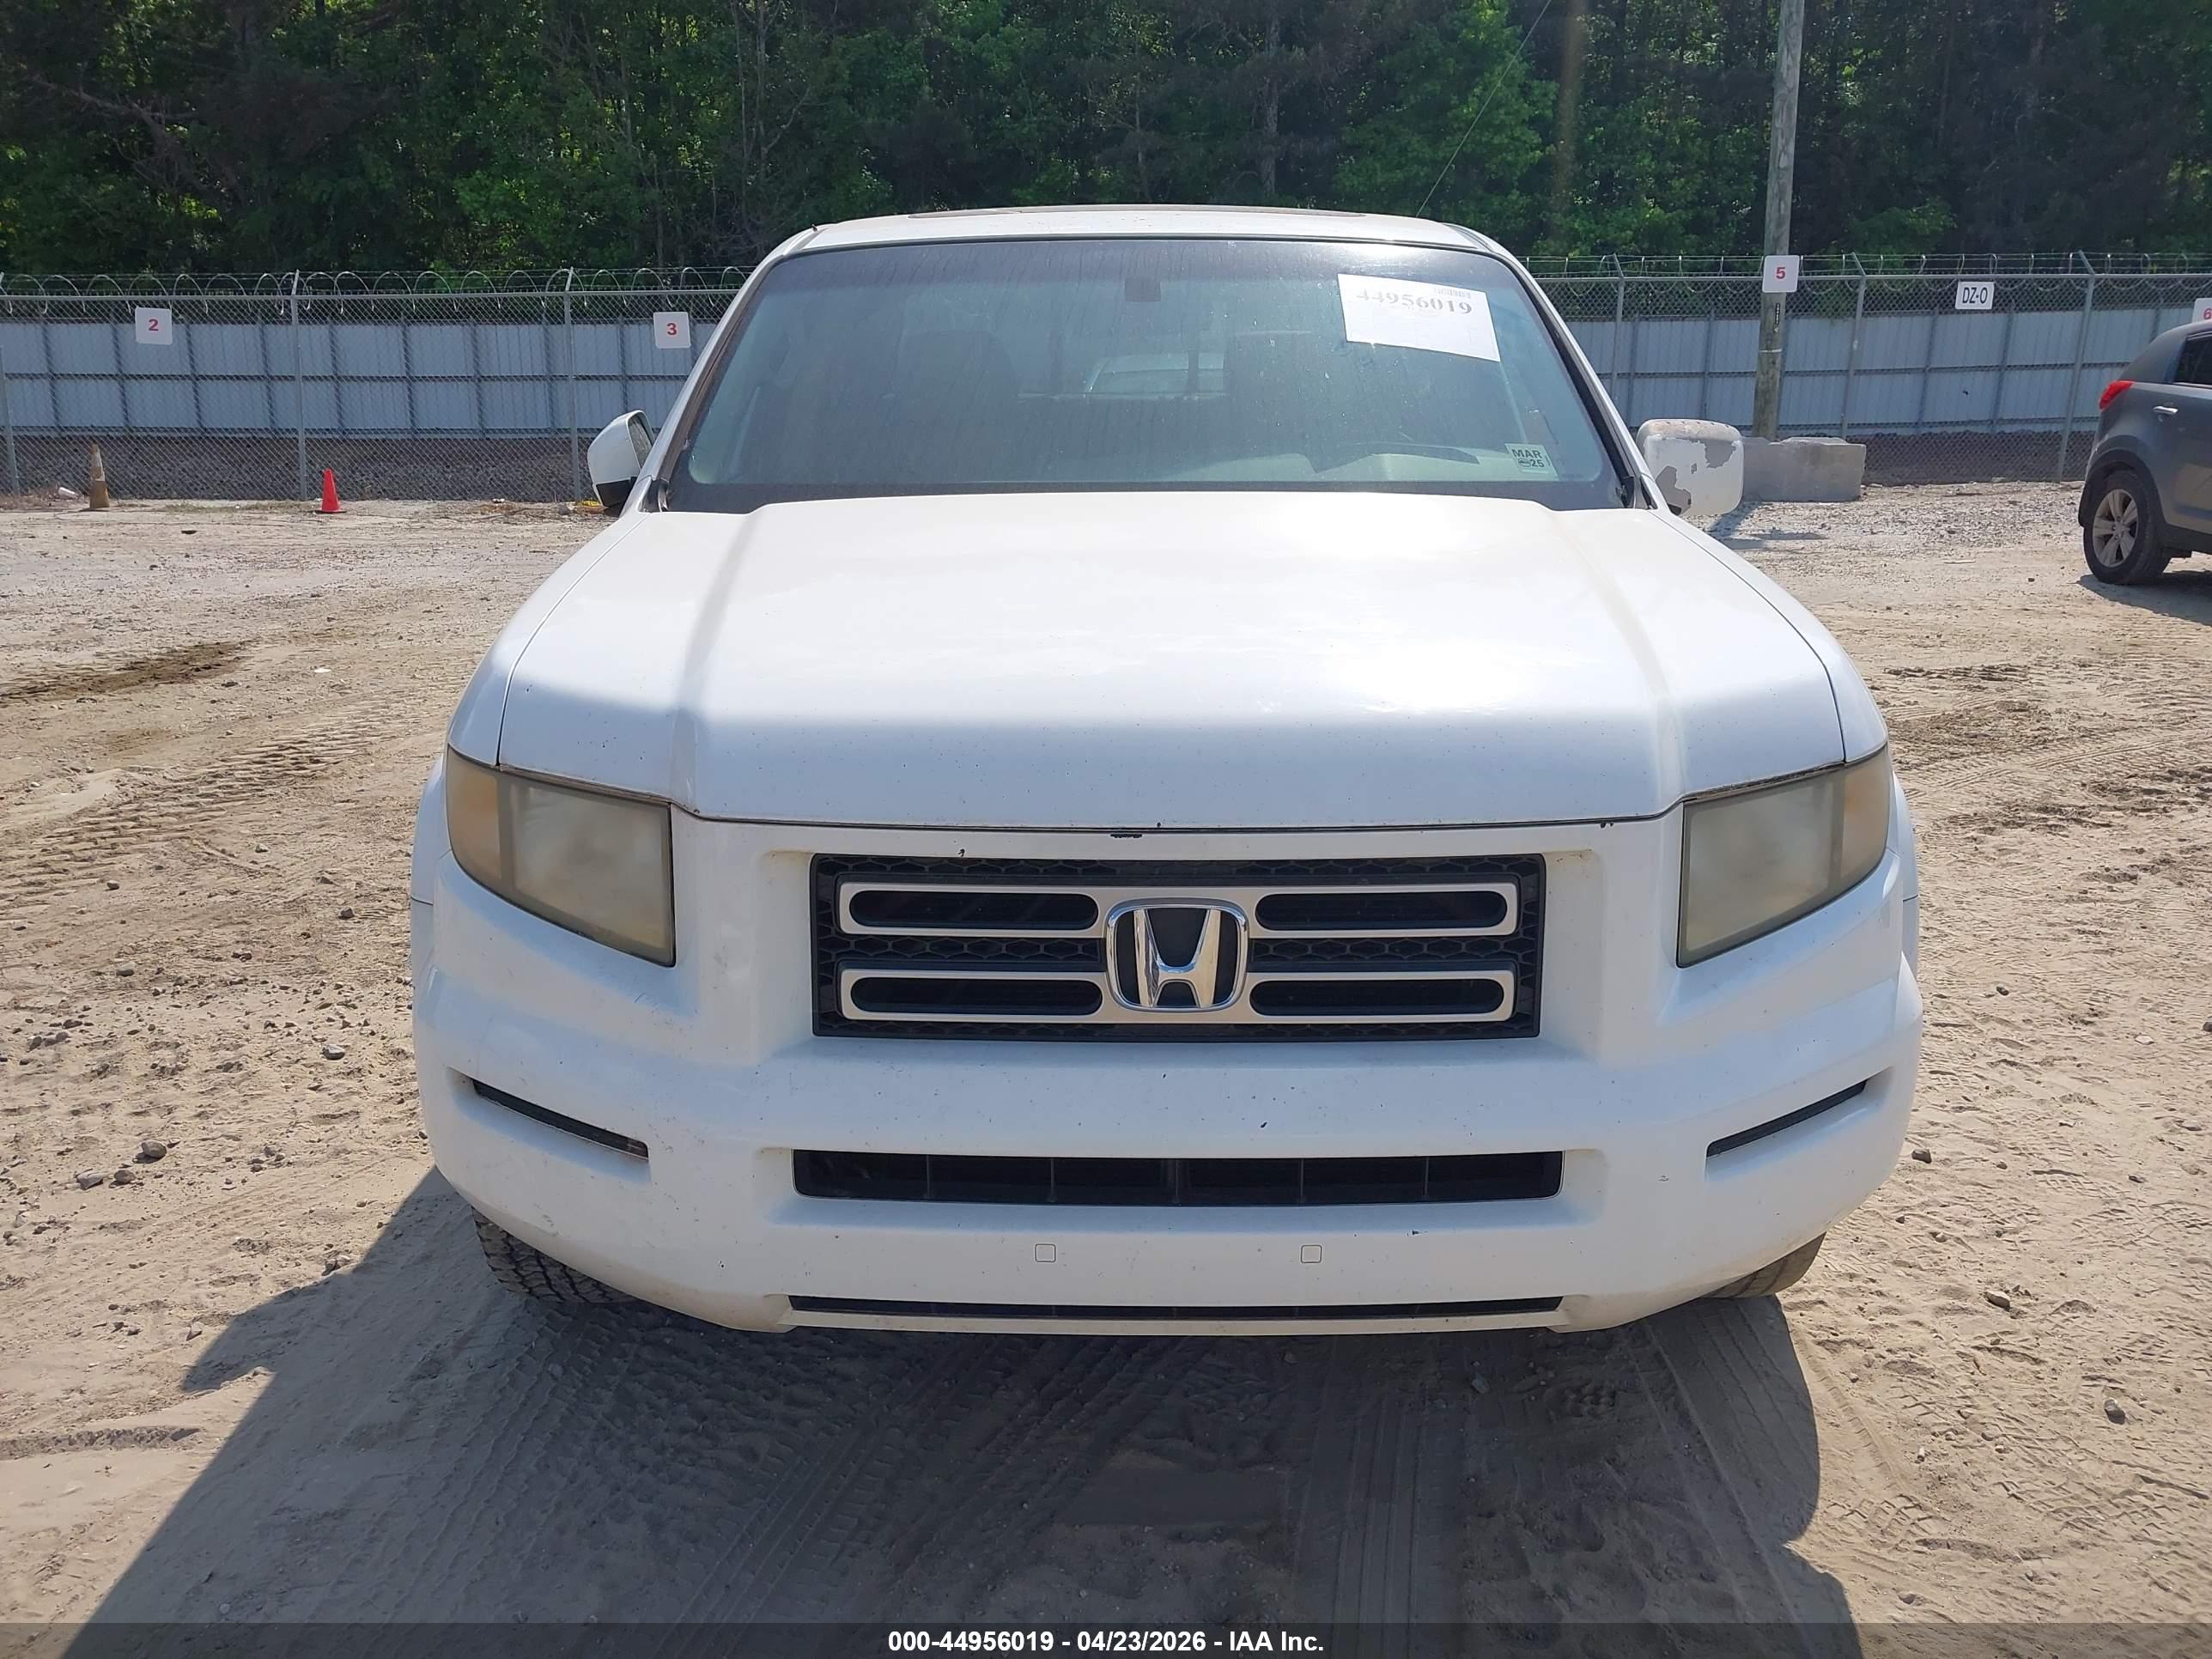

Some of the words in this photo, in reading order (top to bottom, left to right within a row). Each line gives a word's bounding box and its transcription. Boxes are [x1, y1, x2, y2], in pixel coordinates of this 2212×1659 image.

[1776, 266, 1786, 280] 5
[1357, 288, 1473, 314] 44956019
[149, 319, 159, 331] 2
[667, 322, 678, 336] 3
[1511, 449, 1542, 459] MAR
[1530, 459, 1545, 468] 25
